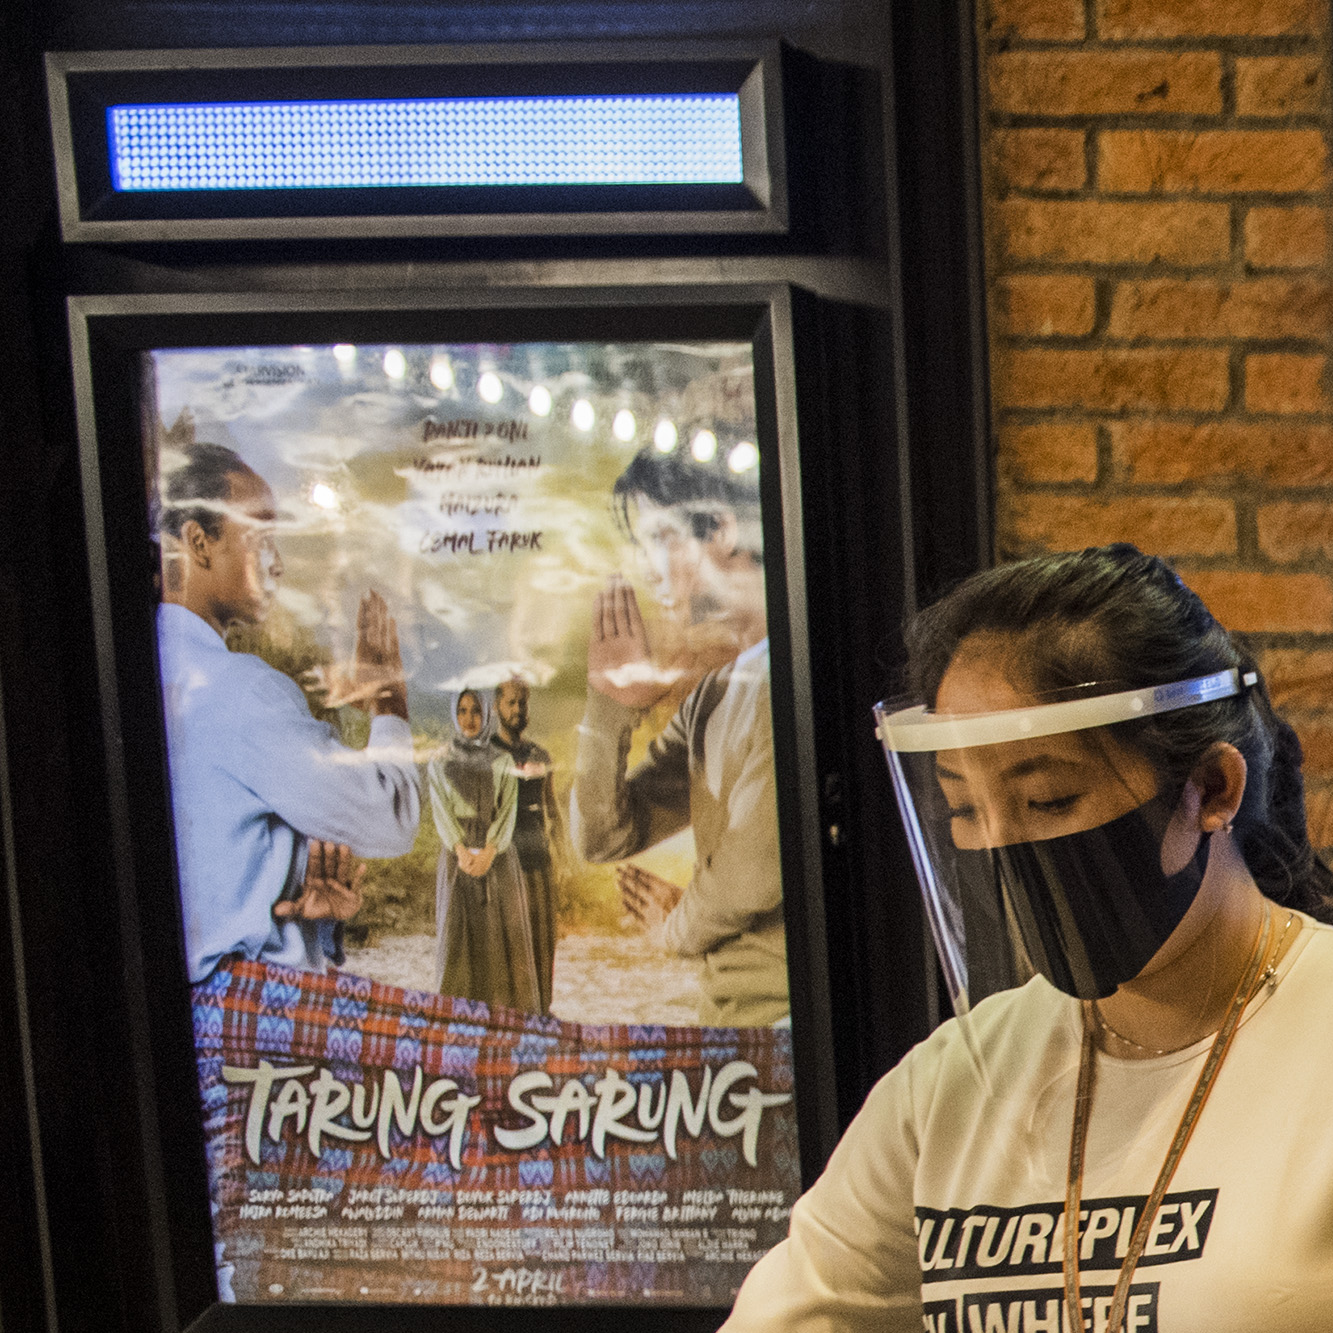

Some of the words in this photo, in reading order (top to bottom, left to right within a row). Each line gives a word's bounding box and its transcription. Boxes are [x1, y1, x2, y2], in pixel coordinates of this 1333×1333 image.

[222, 1058, 482, 1170] TARUNG
[493, 1059, 793, 1168] SARUNG
[914, 1200, 1211, 1272] ULTUREPLEX
[471, 1267, 490, 1293] 2
[491, 1266, 568, 1294] APRIL
